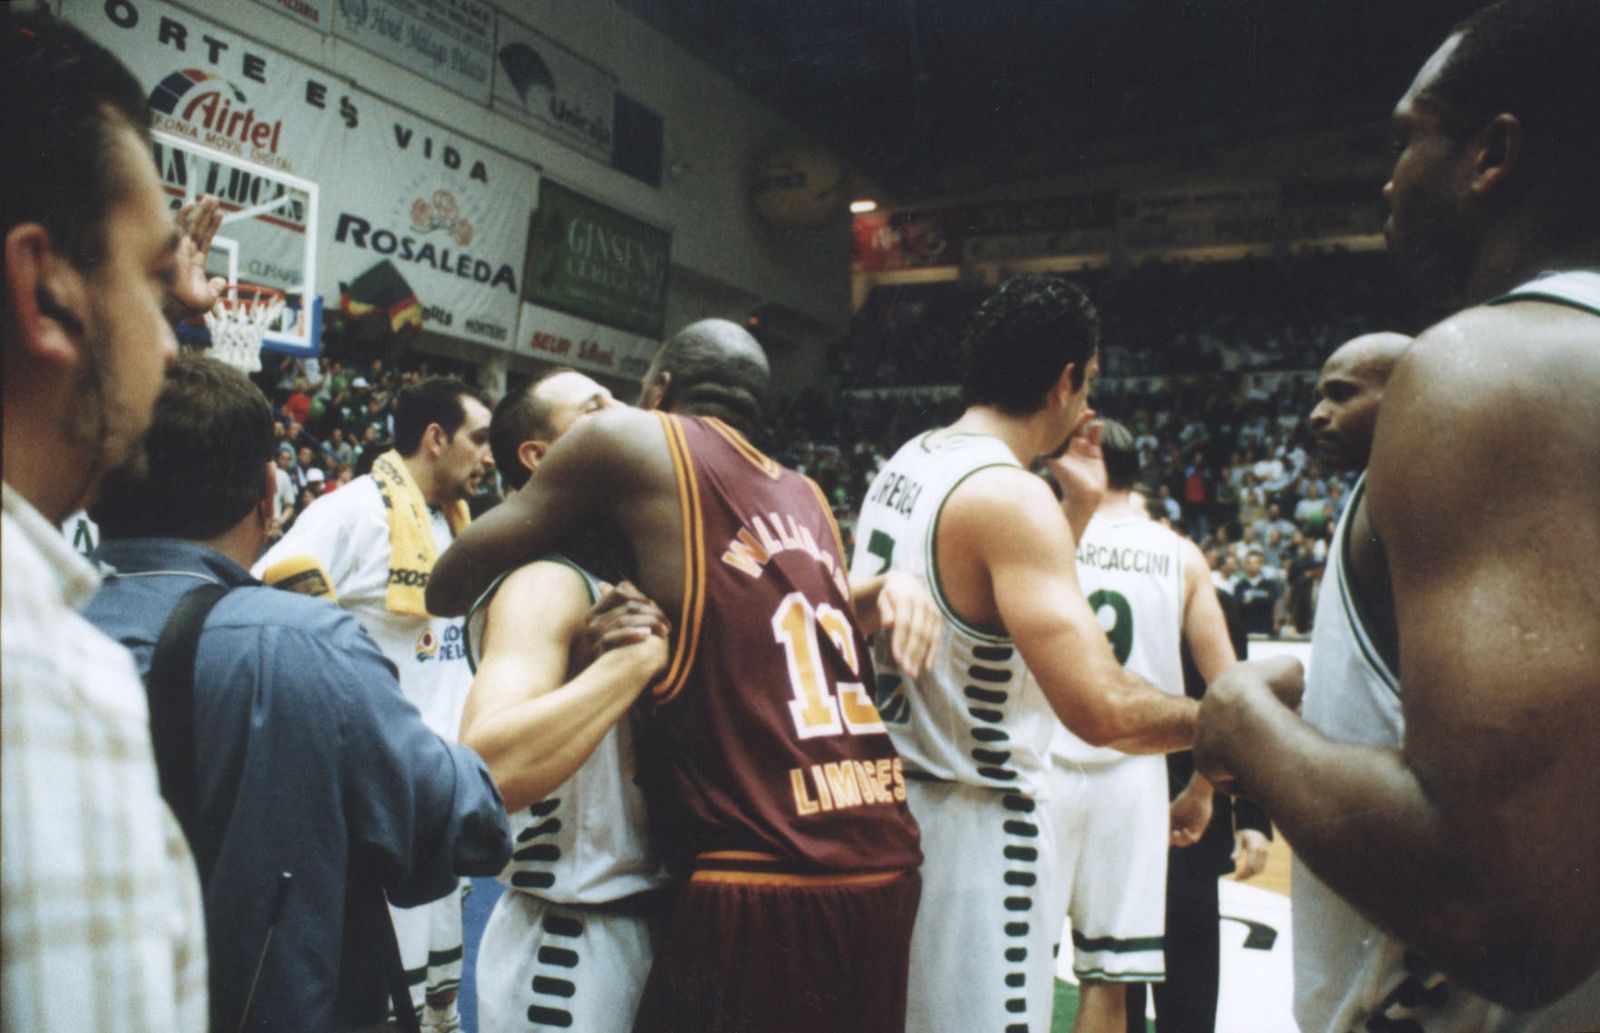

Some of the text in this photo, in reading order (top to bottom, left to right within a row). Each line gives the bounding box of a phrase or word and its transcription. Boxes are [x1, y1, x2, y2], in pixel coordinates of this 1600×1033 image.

[182, 91, 282, 153] Airtel
[305, 80, 358, 129] ES
[394, 124, 488, 184] VIDA
[335, 212, 517, 294] ROSALEDA
[1087, 588, 1133, 668] 9
